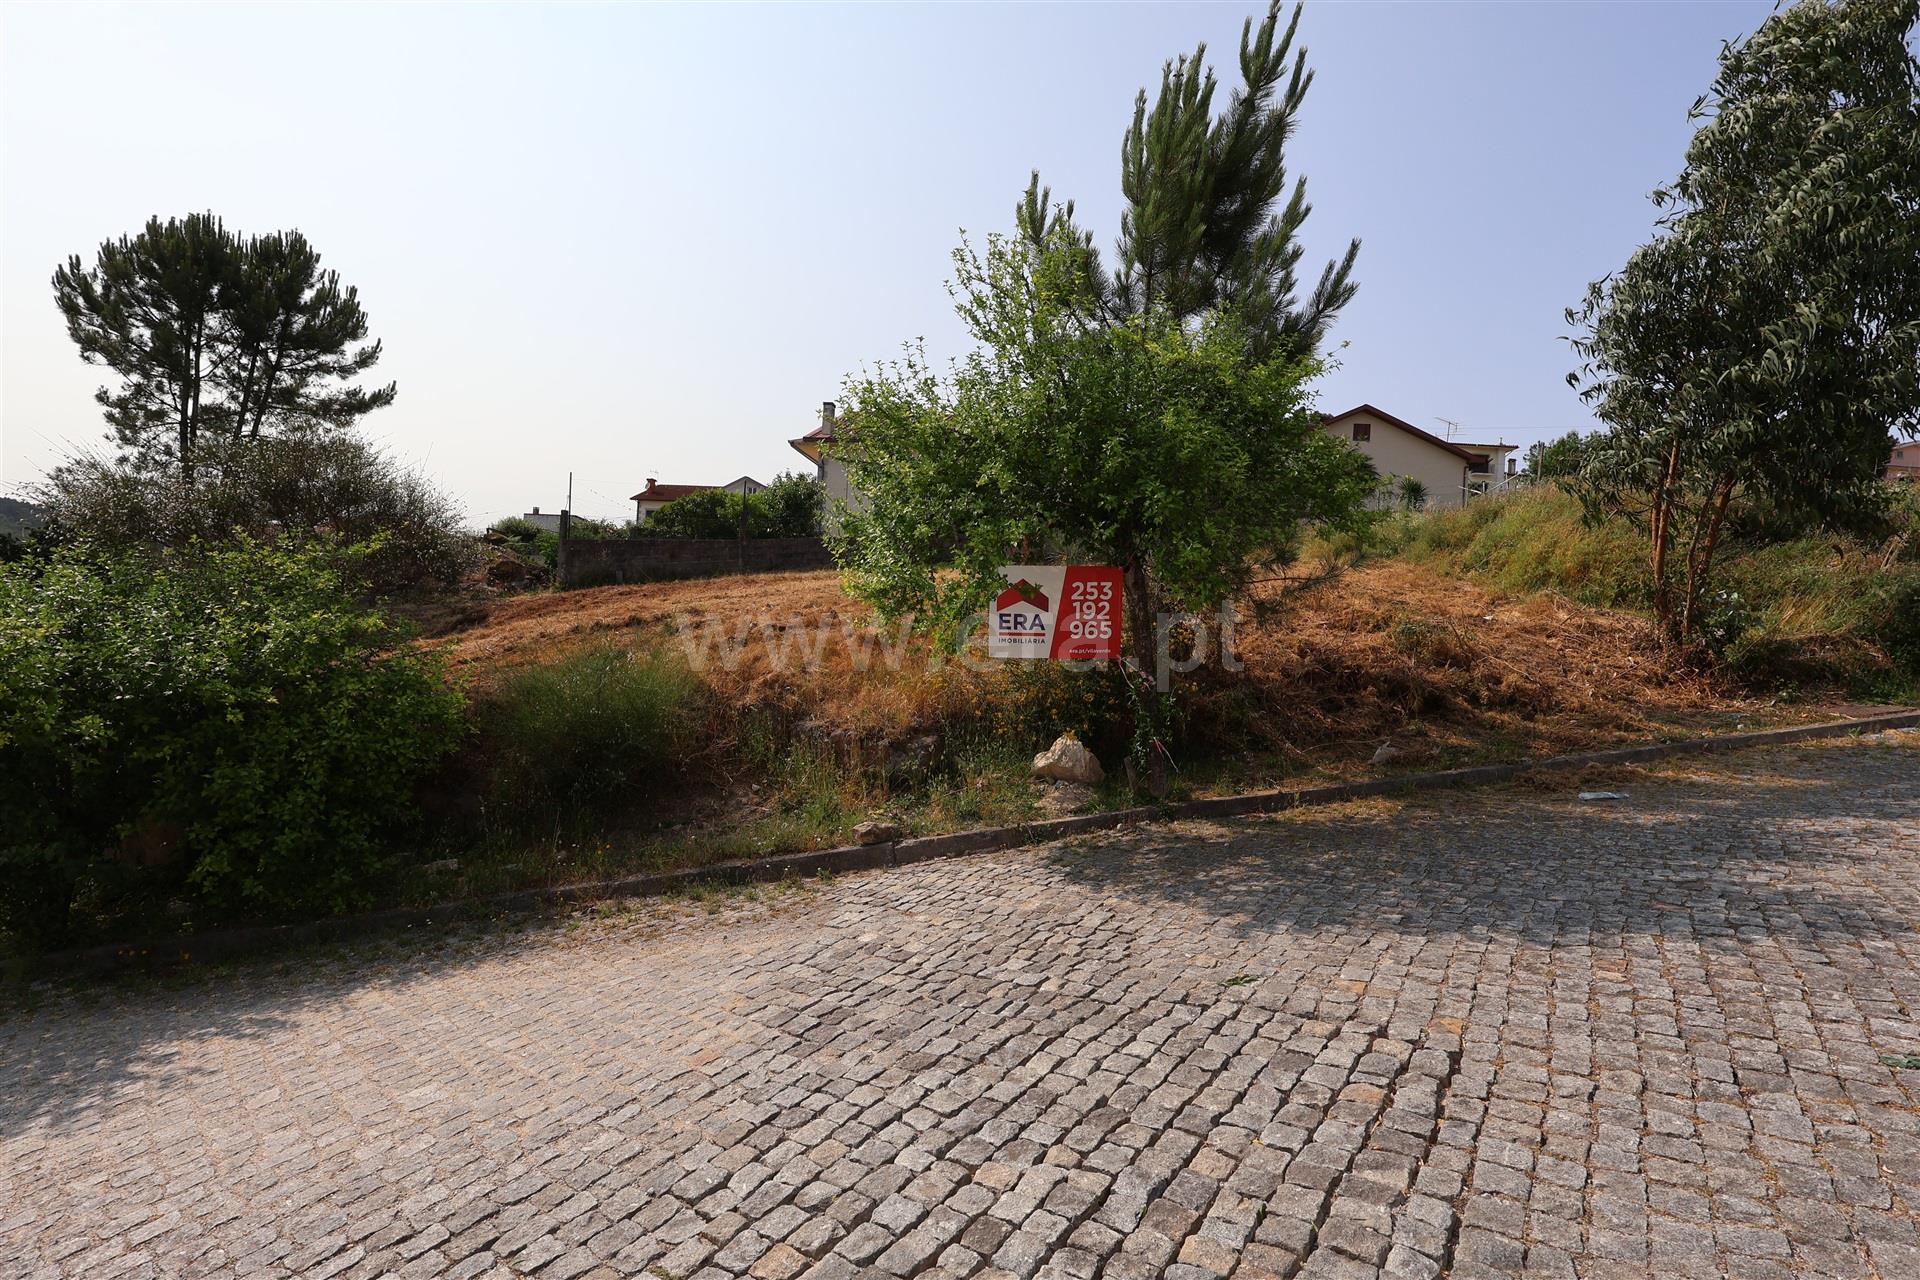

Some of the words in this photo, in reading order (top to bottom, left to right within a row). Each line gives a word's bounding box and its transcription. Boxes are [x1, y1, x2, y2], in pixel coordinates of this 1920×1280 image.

[1071, 581, 1113, 600] 253
[1072, 601, 1111, 620] 192
[998, 613, 1046, 631] ERA
[1069, 621, 1113, 639] 965
[998, 637, 1046, 645] IMOBILIÁRIA
